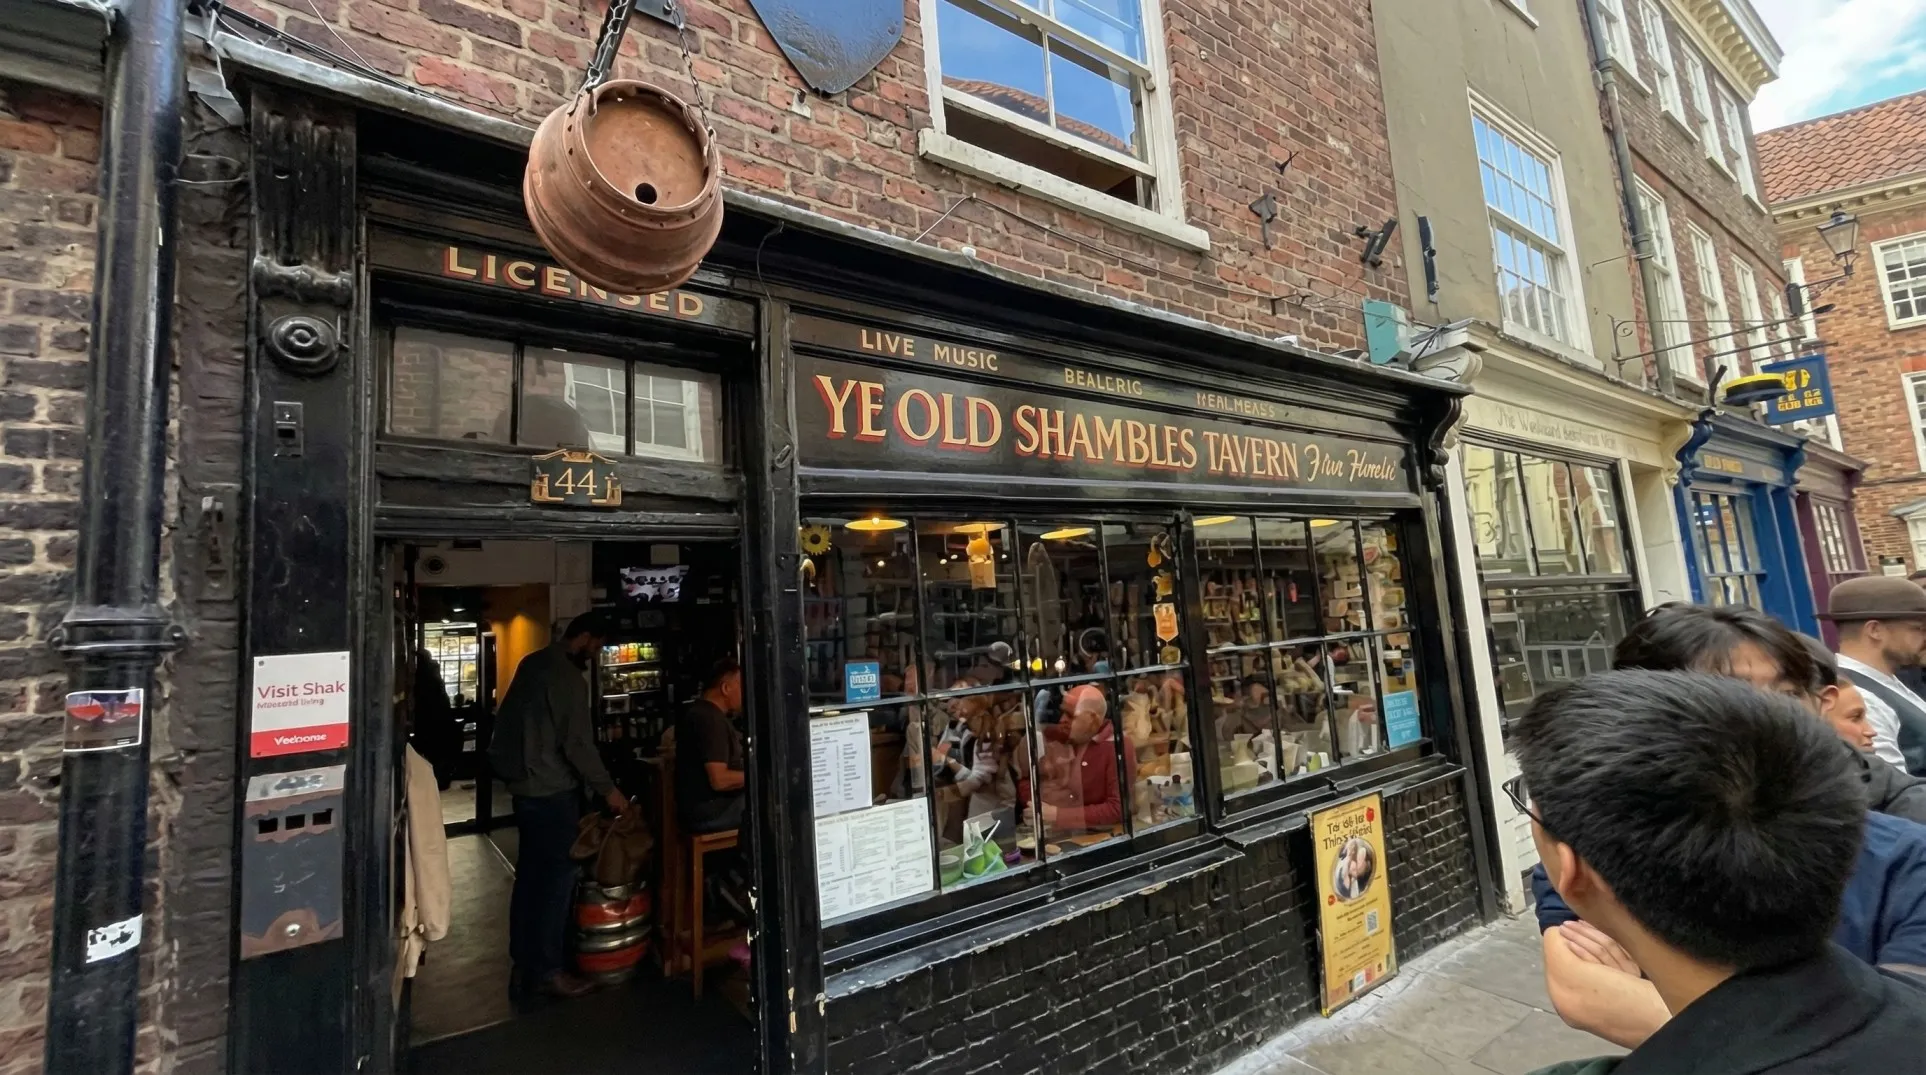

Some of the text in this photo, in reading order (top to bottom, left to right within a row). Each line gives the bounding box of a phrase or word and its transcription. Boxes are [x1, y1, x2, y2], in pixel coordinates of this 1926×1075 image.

[861, 329, 998, 371] LIVE MUSIC
[811, 374, 887, 442] YE
[892, 388, 1003, 452] OLD
[1012, 404, 1198, 475] SHAMBLES
[1201, 430, 1300, 481] TAVERN
[554, 467, 598, 496] 44
[257, 680, 346, 699] Visit Shak
